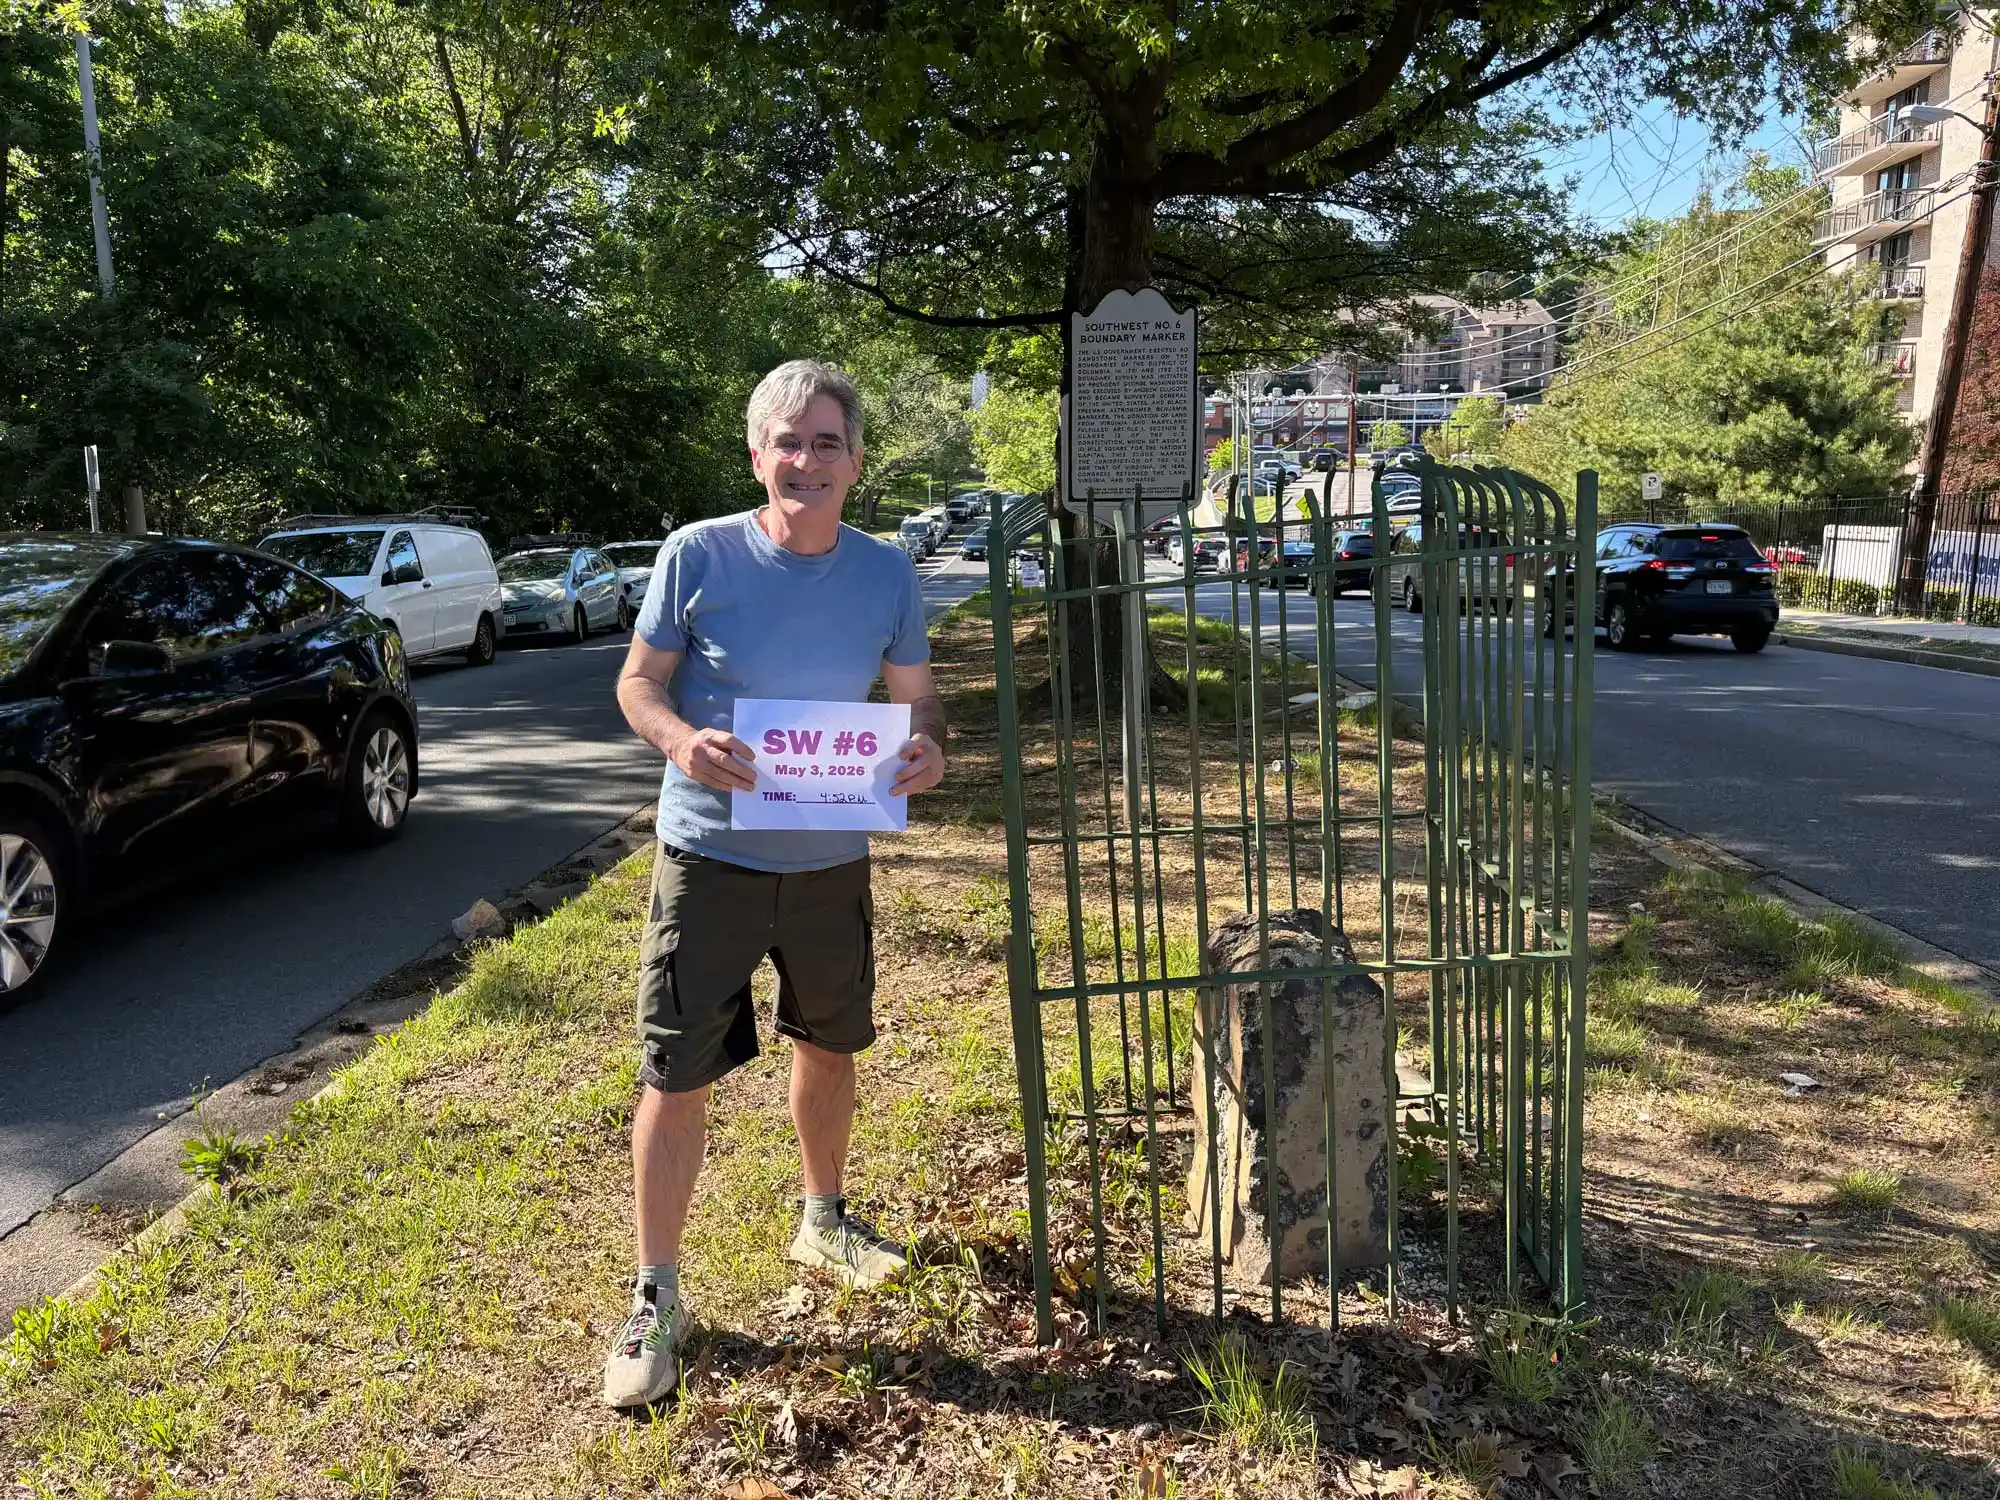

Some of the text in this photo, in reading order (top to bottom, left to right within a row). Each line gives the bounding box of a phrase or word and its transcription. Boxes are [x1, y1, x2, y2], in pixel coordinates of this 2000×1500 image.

[1085, 322, 1149, 331] SOUTHWEST
[1155, 321, 1172, 329] NO.
[1080, 333, 1186, 343] BOUNDARY MARKER
[762, 728, 878, 756] SW #6
[775, 764, 865, 777] May 3, 2026
[762, 792, 796, 801] TIME:
